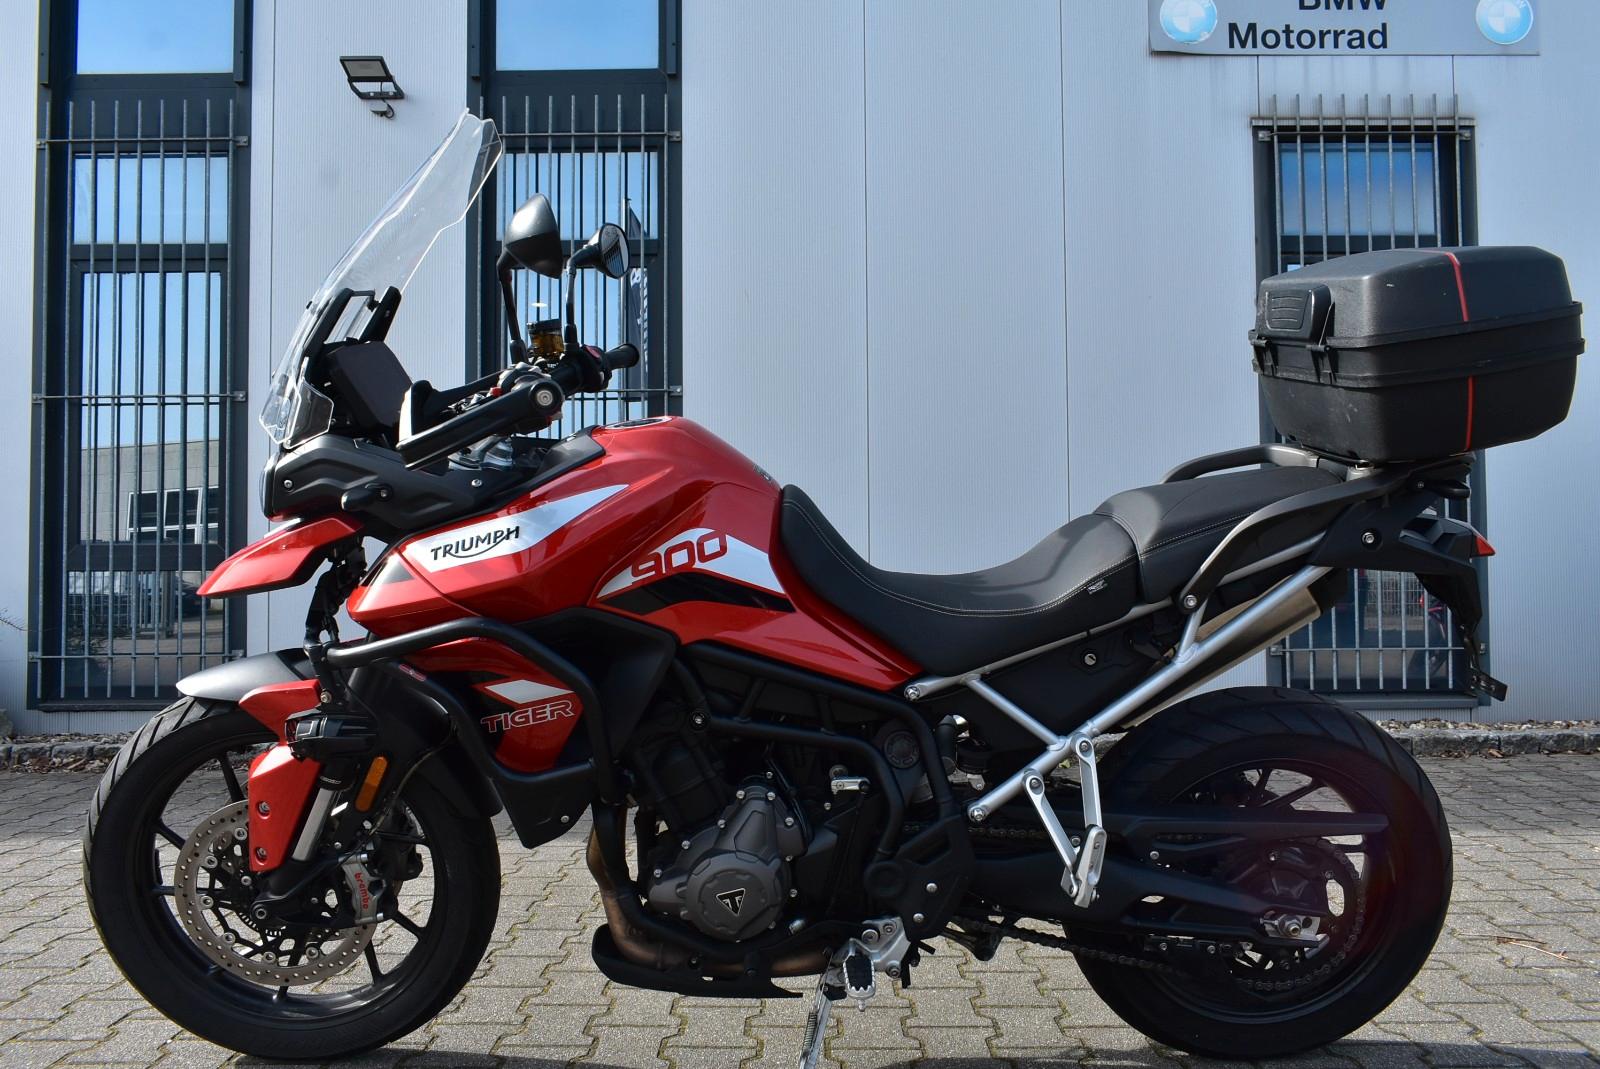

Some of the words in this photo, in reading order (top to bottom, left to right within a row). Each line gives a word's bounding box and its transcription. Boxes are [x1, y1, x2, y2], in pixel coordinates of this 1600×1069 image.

[1228, 22, 1388, 49] Motorrad
[430, 525, 520, 561] TRIUMPH
[631, 530, 728, 583] 900
[480, 700, 575, 733] TIGER
[354, 871, 369, 911] brembo
